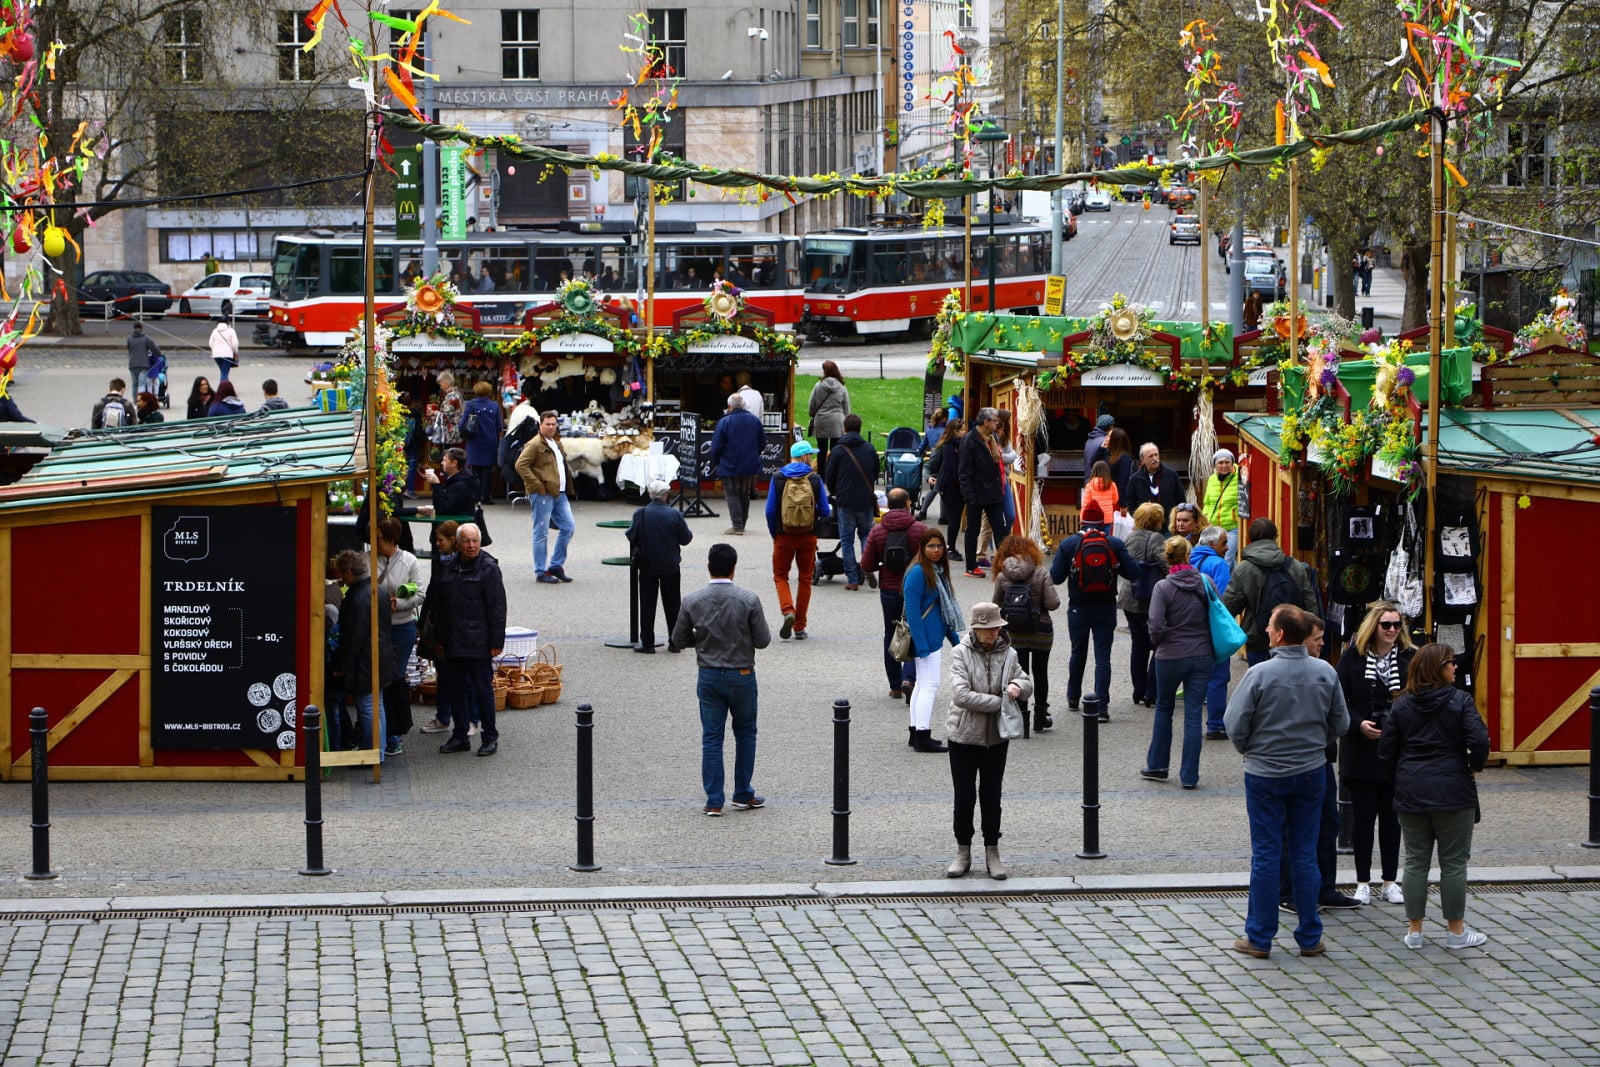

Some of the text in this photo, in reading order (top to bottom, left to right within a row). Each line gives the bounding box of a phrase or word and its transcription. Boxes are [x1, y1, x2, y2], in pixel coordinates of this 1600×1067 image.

[559, 90, 610, 103] PRAHA
[1049, 514, 1081, 535] HALU
[174, 531, 199, 540] MLS
[163, 577, 246, 592] TRDELNÍK
[163, 604, 211, 613] MANDLOVÝ
[163, 616, 212, 625] SKOŘICOVÝ
[163, 627, 210, 637] KOKOSOVÝ
[264, 633, 283, 643] 50,-
[163, 639, 233, 649] VLAŠSKÝ OŘECH
[163, 652, 207, 660] S POVIDLY
[163, 662, 224, 672] S ČOKOLÁDOU
